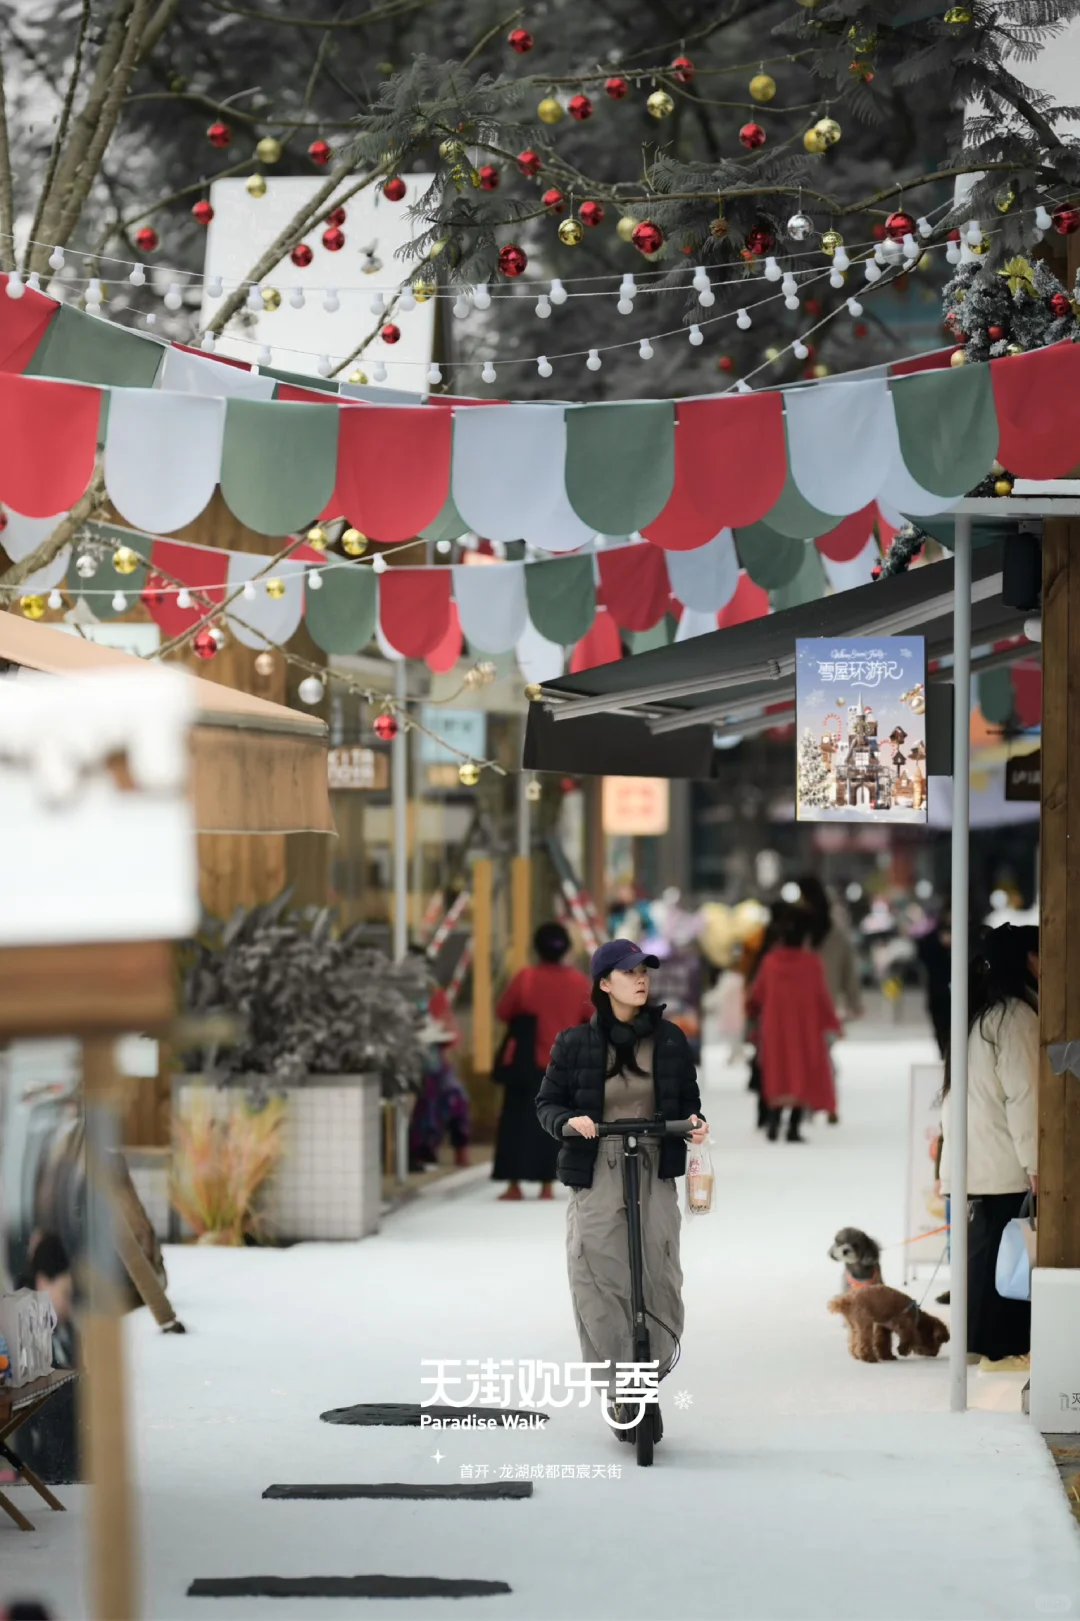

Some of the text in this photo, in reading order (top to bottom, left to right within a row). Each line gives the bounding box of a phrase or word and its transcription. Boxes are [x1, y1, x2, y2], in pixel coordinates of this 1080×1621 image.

[816, 660, 903, 688] 雪屋环游记
